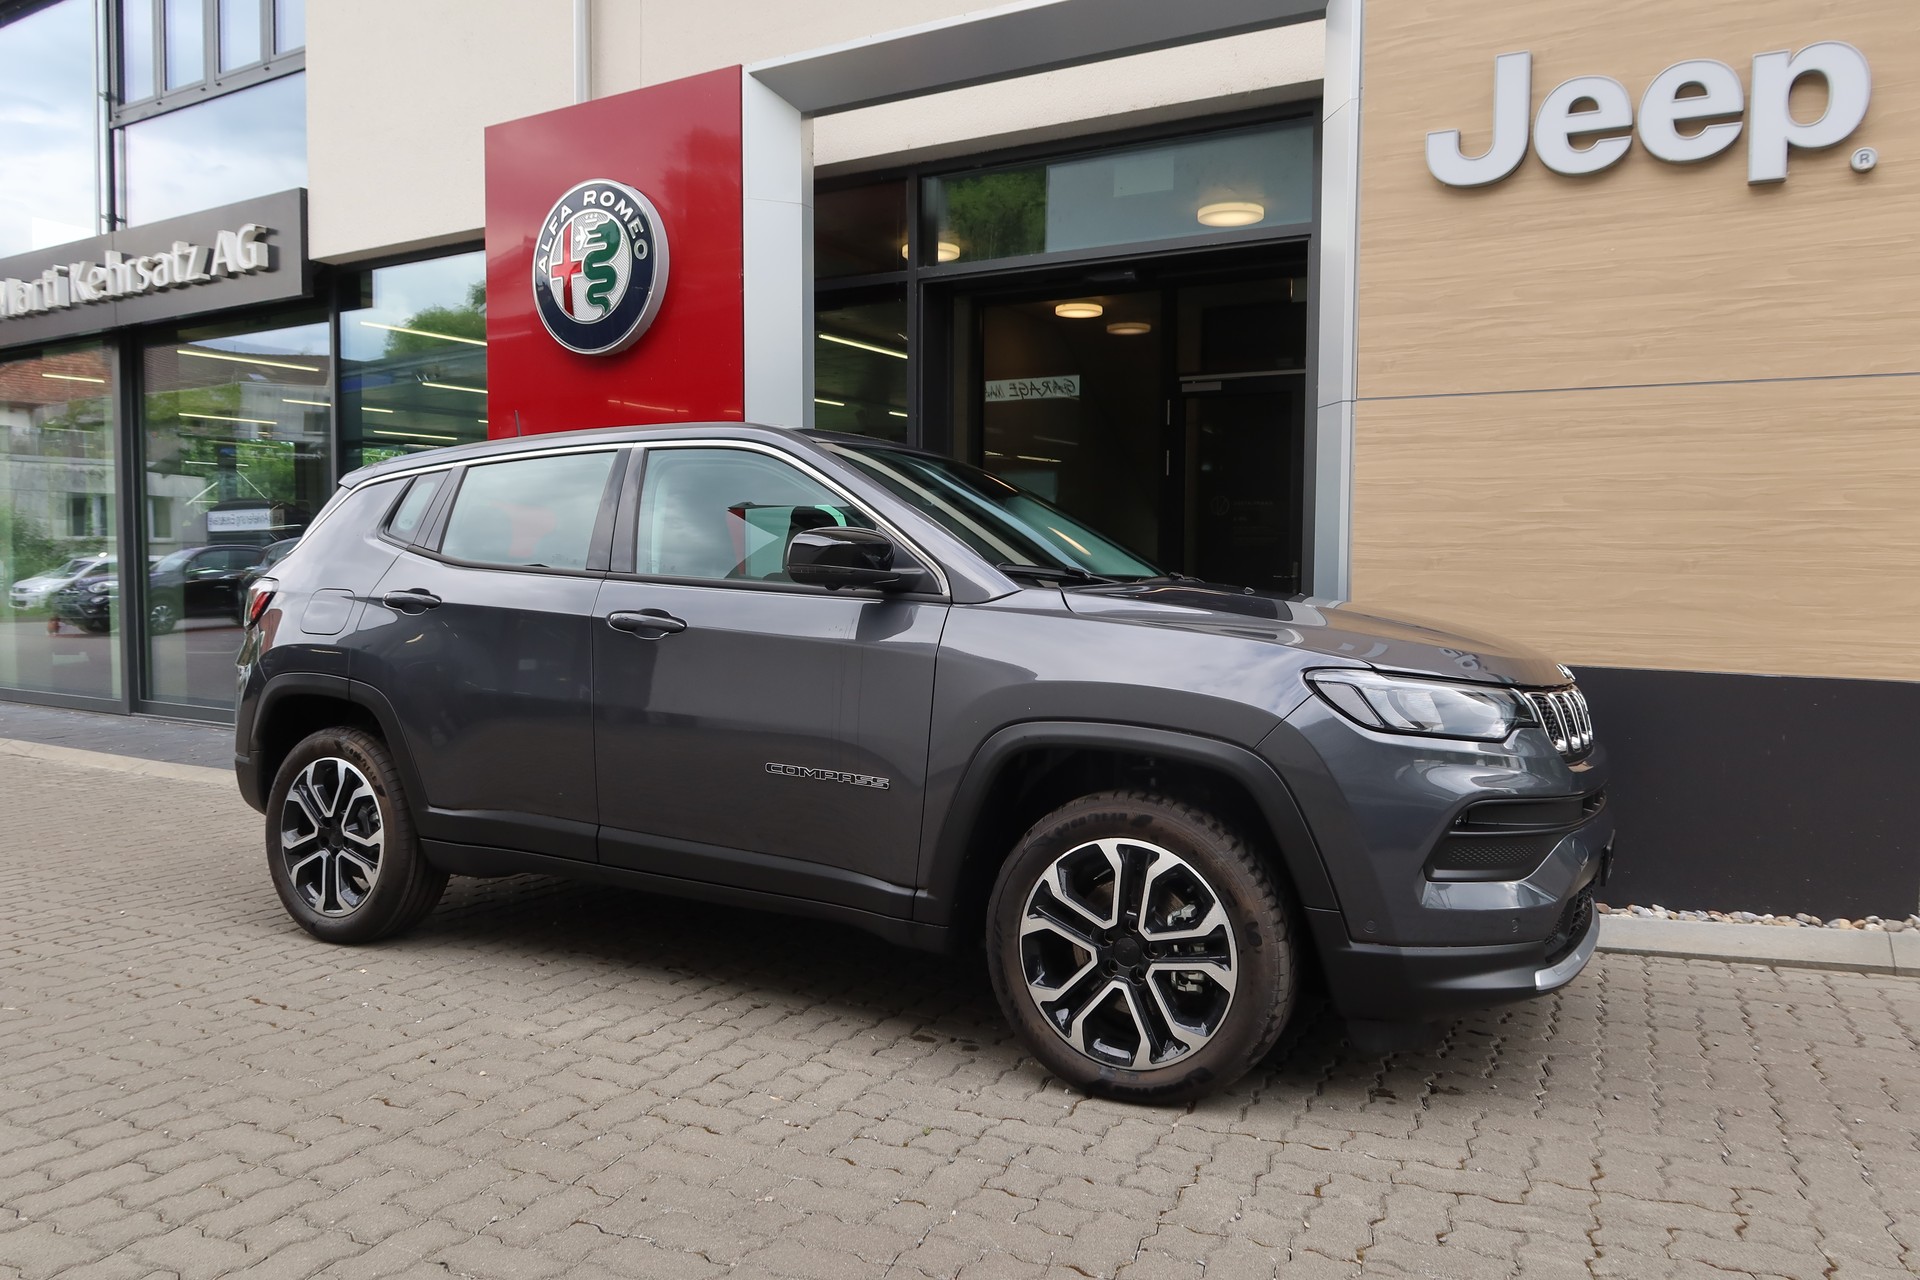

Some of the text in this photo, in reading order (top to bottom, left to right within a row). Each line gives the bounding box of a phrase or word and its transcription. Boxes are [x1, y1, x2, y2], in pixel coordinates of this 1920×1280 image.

[1425, 40, 1872, 187] Jeep
[69, 240, 210, 303] Kehrsatz
[210, 223, 269, 276] AG
[538, 190, 648, 274] ALFA ROMEO
[765, 761, 890, 790] COMPASS
